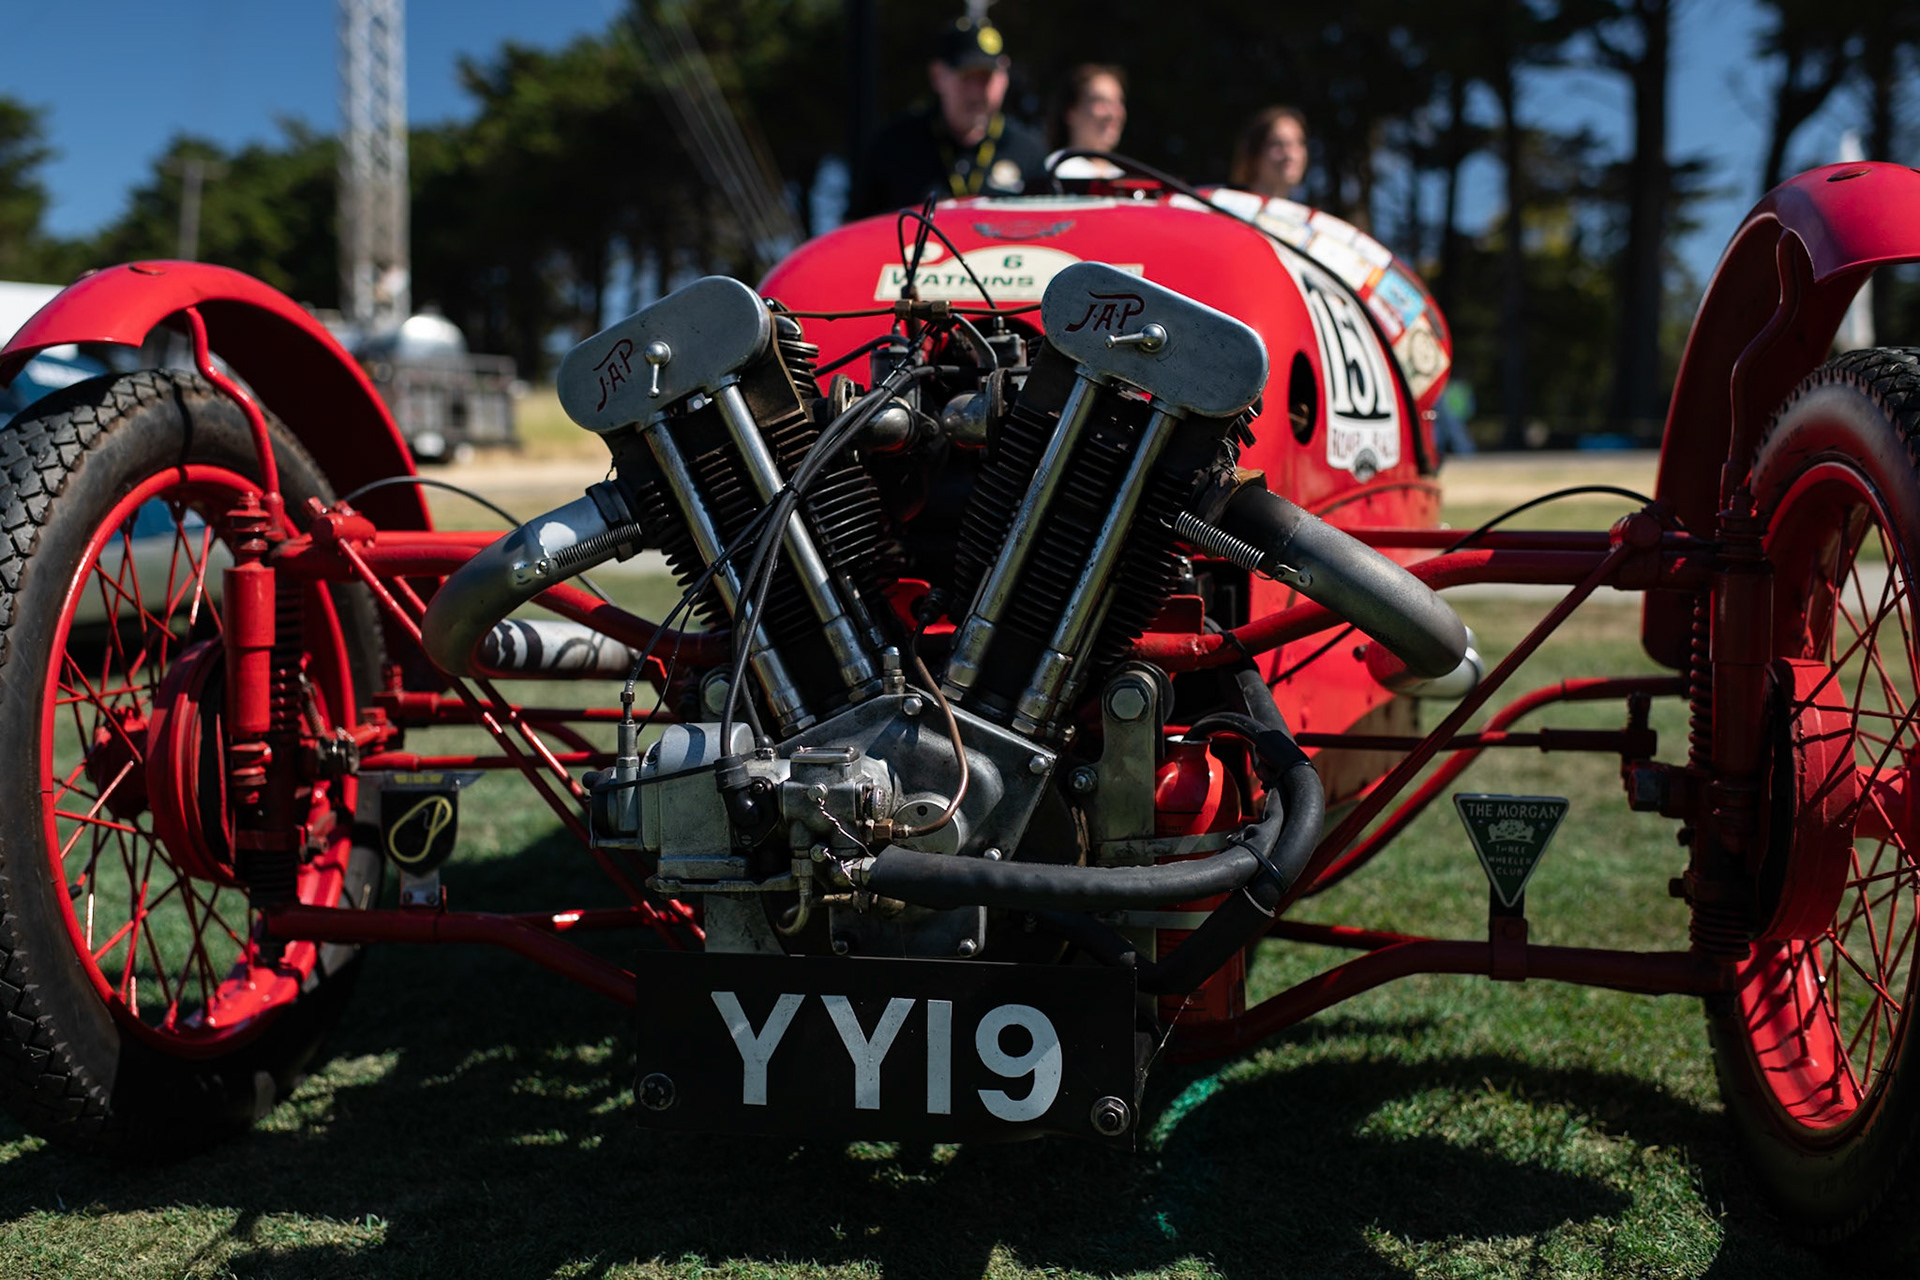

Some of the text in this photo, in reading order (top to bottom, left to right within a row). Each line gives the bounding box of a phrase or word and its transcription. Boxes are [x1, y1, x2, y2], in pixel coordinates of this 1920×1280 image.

[1003, 254, 1023, 270] 6
[891, 269, 1036, 287] WATKINS
[1467, 803, 1560, 819] THE MORGAN
